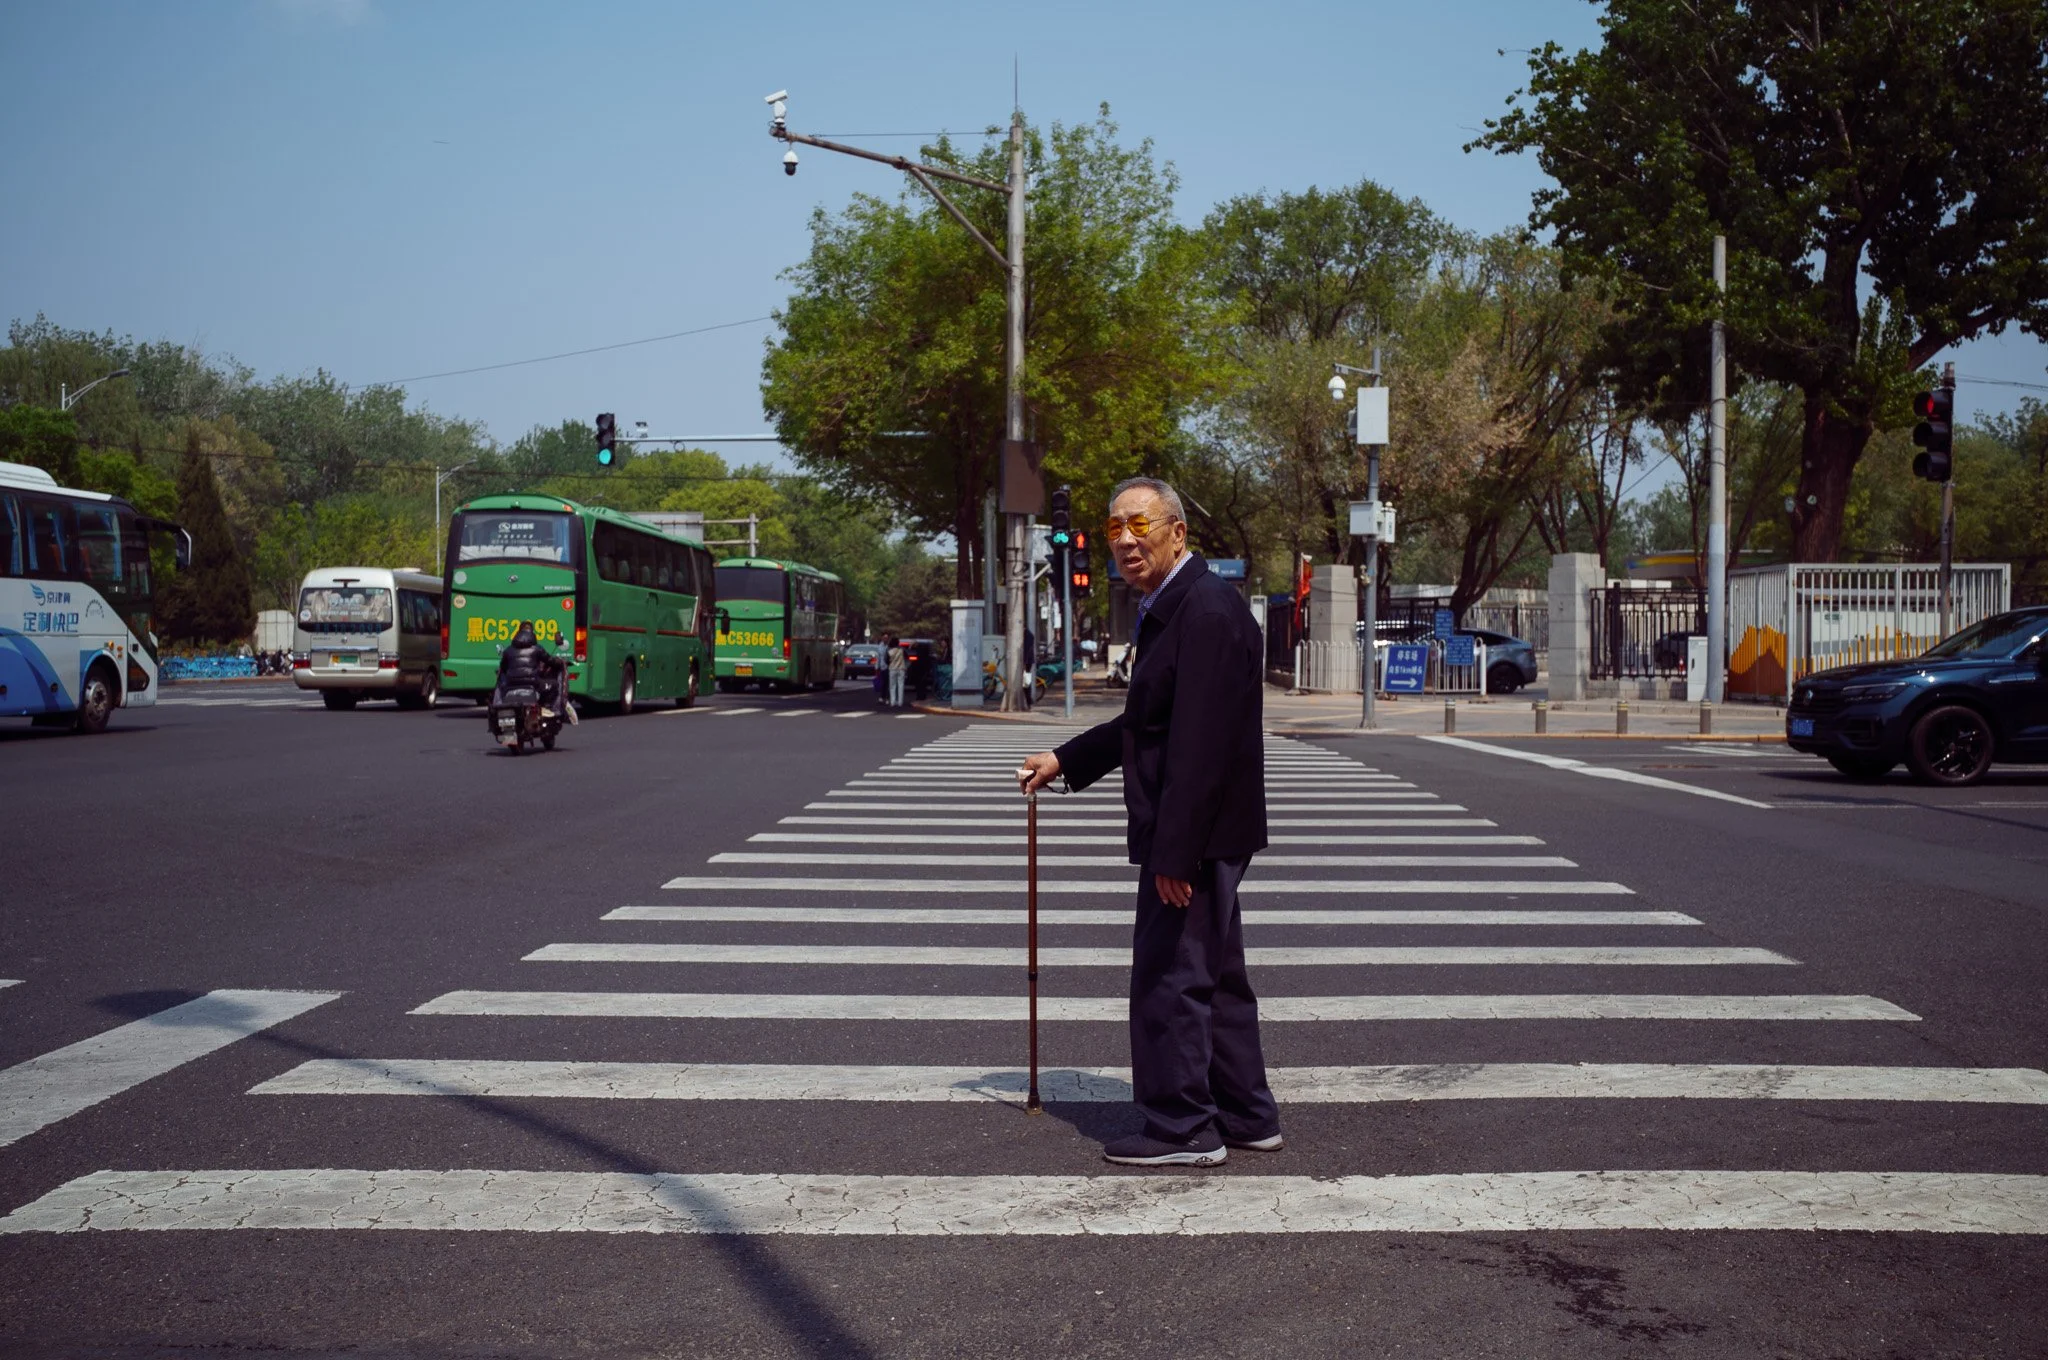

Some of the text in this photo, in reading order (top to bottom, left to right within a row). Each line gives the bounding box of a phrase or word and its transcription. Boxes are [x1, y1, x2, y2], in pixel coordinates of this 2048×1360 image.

[24, 611, 79, 633] 定制快巴
[468, 617, 558, 643] 黑C5299
